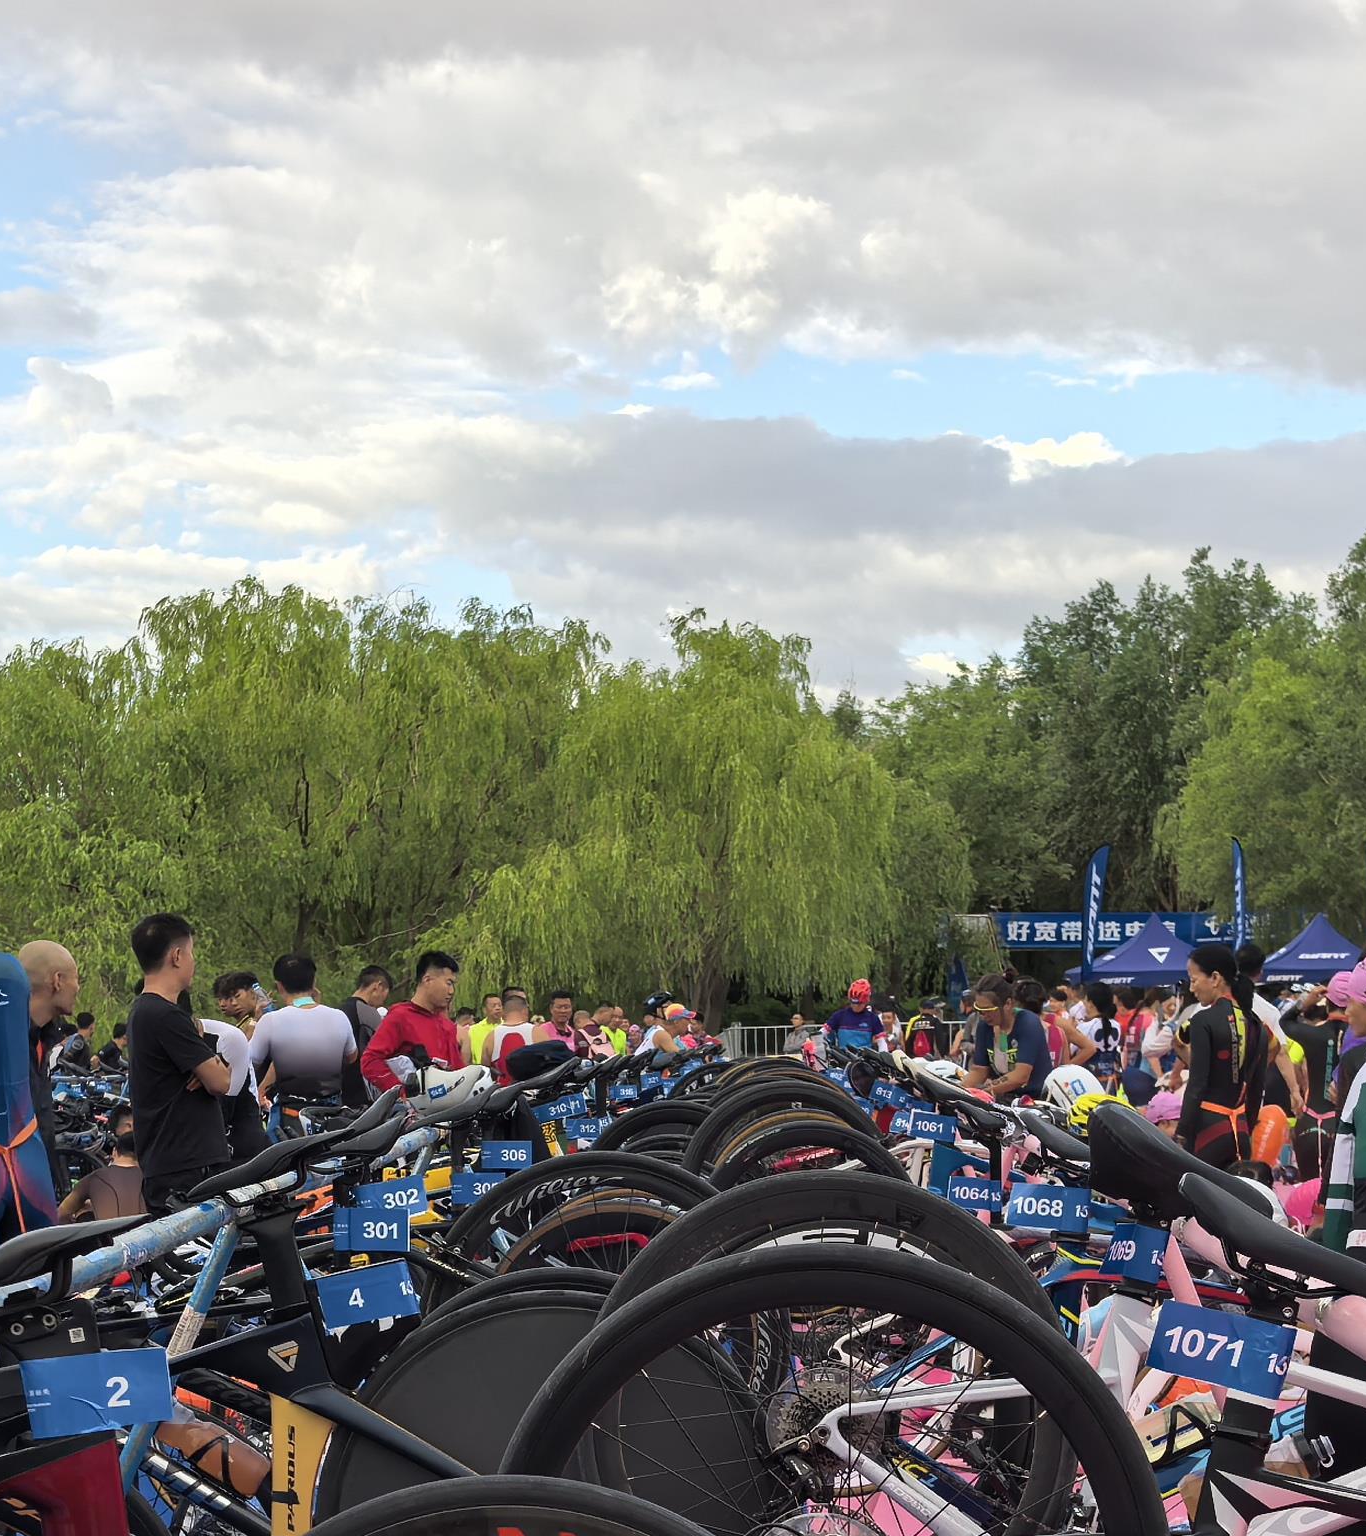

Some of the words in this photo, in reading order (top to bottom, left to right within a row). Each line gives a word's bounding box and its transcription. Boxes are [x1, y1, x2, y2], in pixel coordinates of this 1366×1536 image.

[1007, 919, 1082, 943] 好宽带
[875, 1086, 893, 1099] 813
[579, 1123, 597, 1134] 312
[915, 1120, 944, 1135] 1061
[501, 1149, 527, 1162] 306
[383, 1188, 420, 1209] 302
[951, 1186, 990, 1202] 1064
[1012, 1196, 1064, 1218] 1068
[362, 1222, 399, 1240] 301
[1108, 1239, 1136, 1262] 1069
[348, 1287, 365, 1309] 4
[1164, 1325, 1246, 1368] 1071
[105, 1375, 132, 1409] 2
